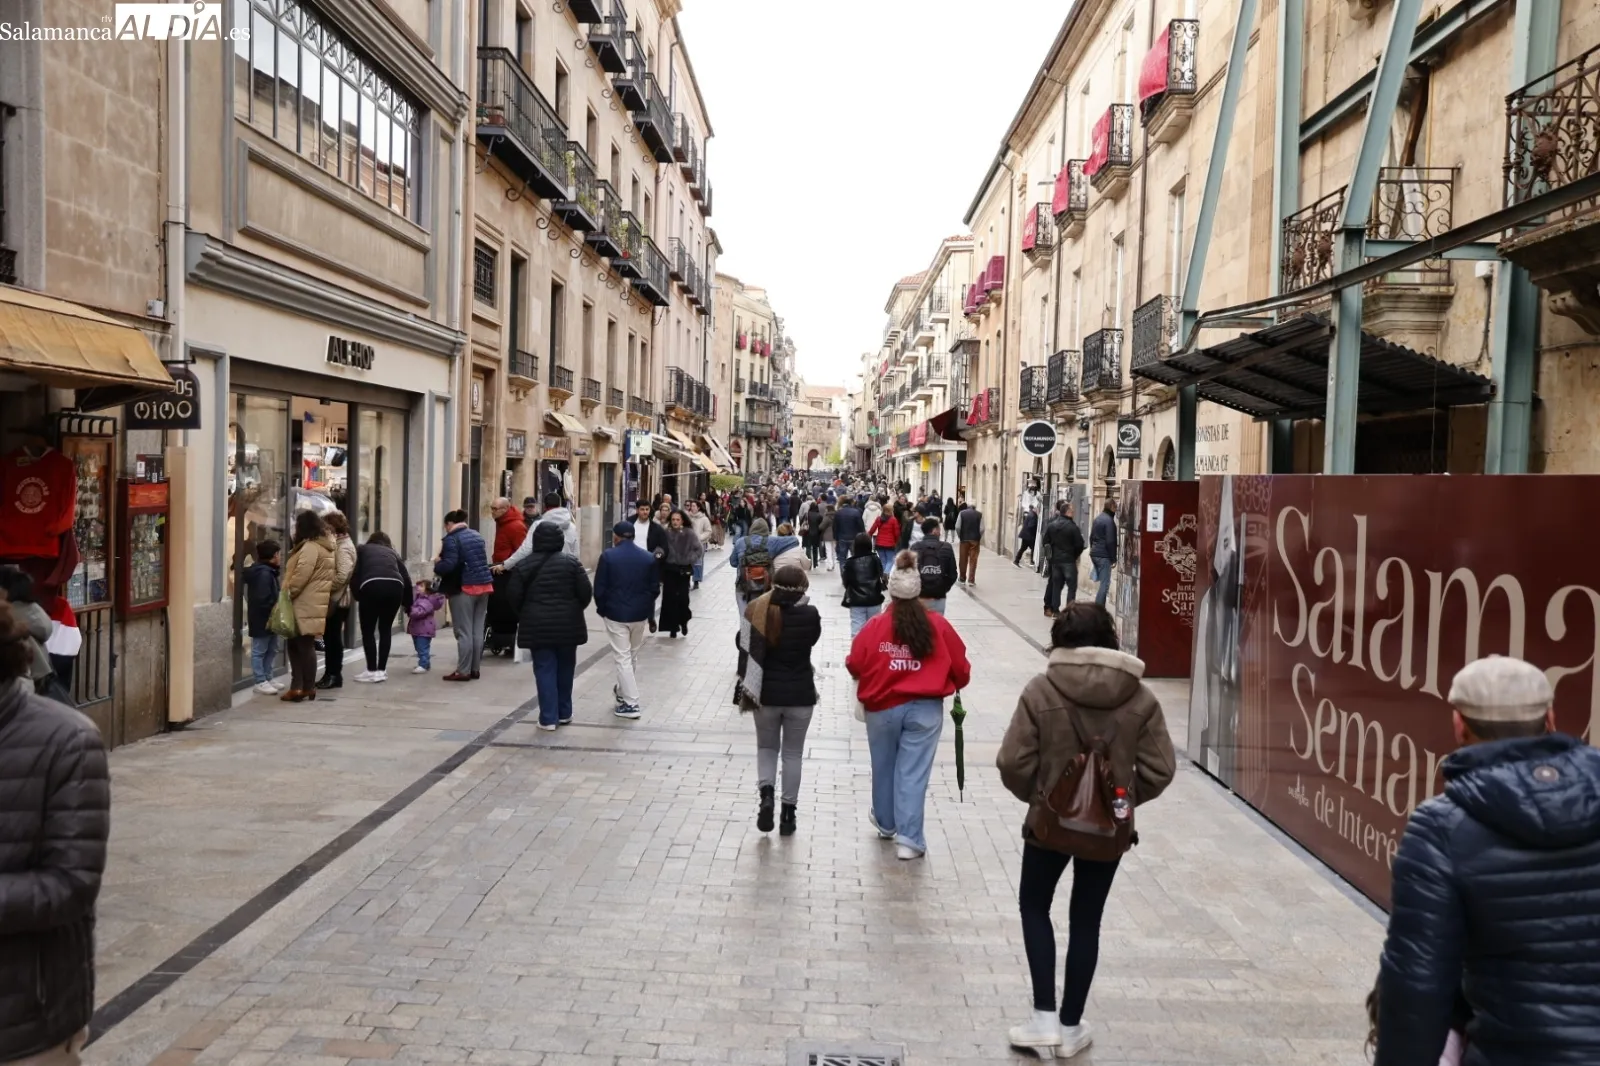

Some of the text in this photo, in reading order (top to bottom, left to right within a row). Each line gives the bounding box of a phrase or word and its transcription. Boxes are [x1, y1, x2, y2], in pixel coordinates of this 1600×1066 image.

[920, 565, 941, 575] VANS
[1314, 784, 1400, 872] de Interé
